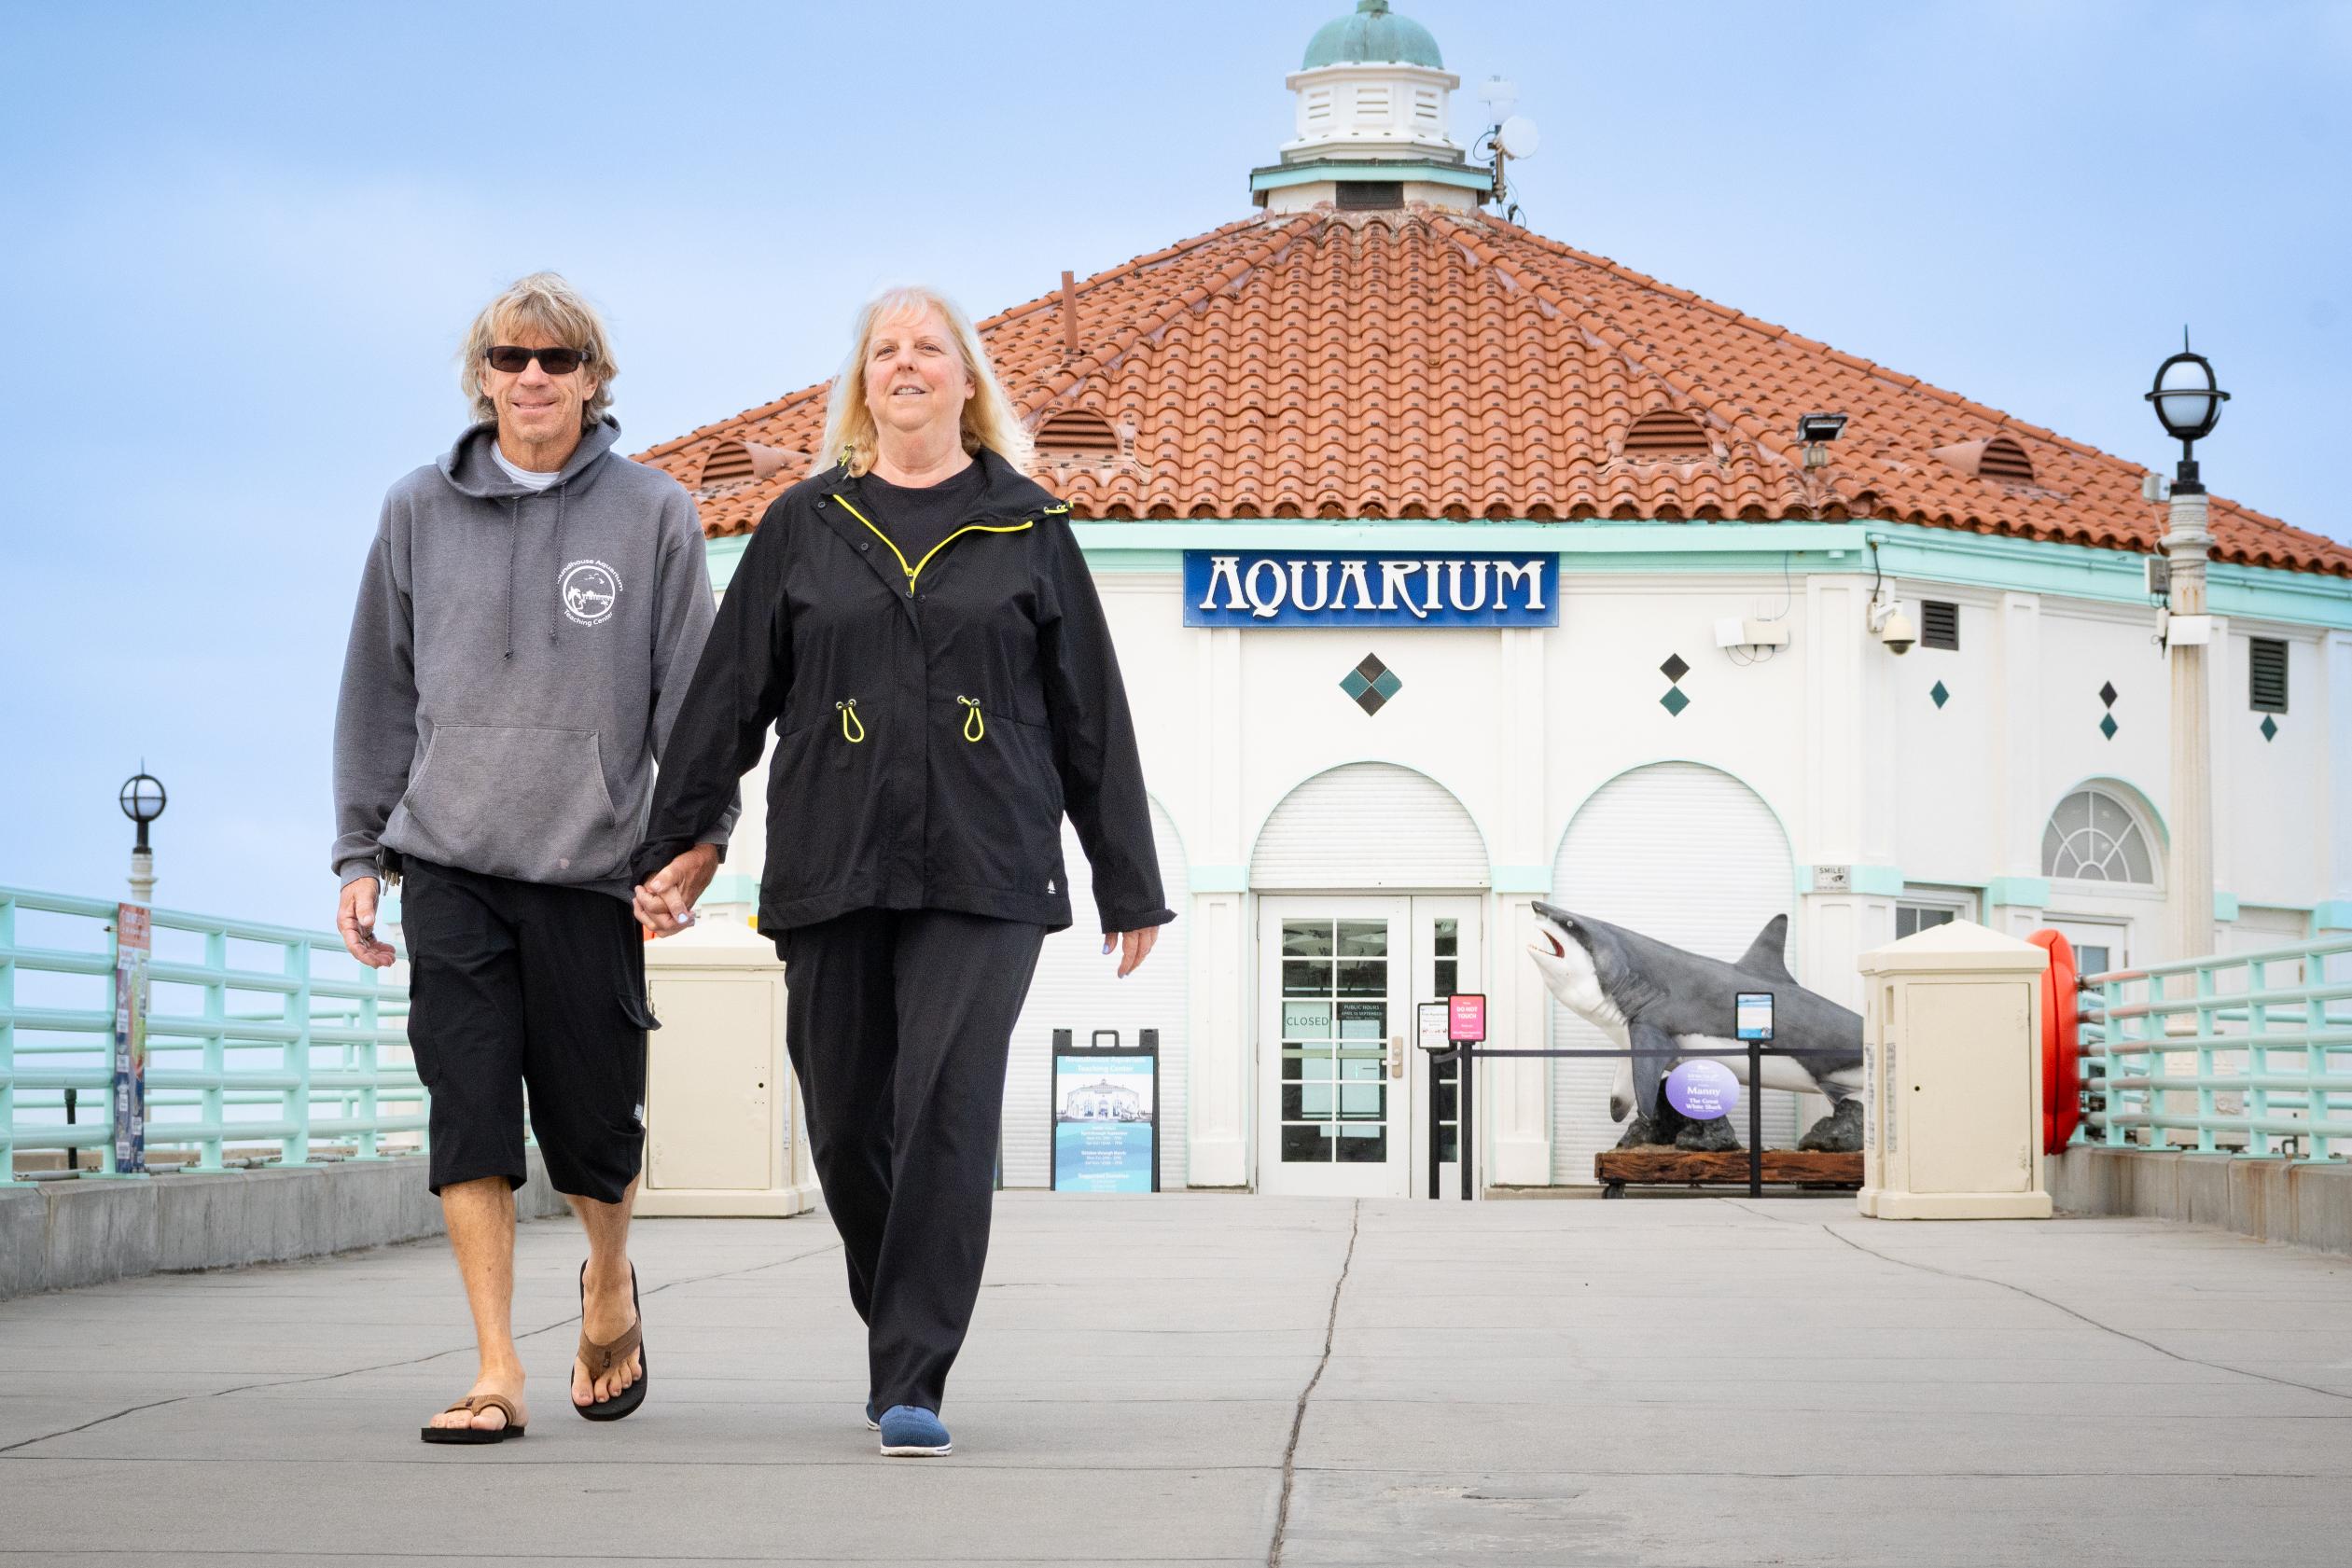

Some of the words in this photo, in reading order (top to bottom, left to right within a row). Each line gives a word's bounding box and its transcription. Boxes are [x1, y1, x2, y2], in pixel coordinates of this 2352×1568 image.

[595, 560, 623, 591] Aquarium
[1200, 556, 1546, 618] AQUARIUM
[564, 608, 592, 627] Teaching
[593, 611, 613, 625] Center
[1287, 1017, 1329, 1026] CLOSED
[1687, 1087, 1721, 1096] Manny
